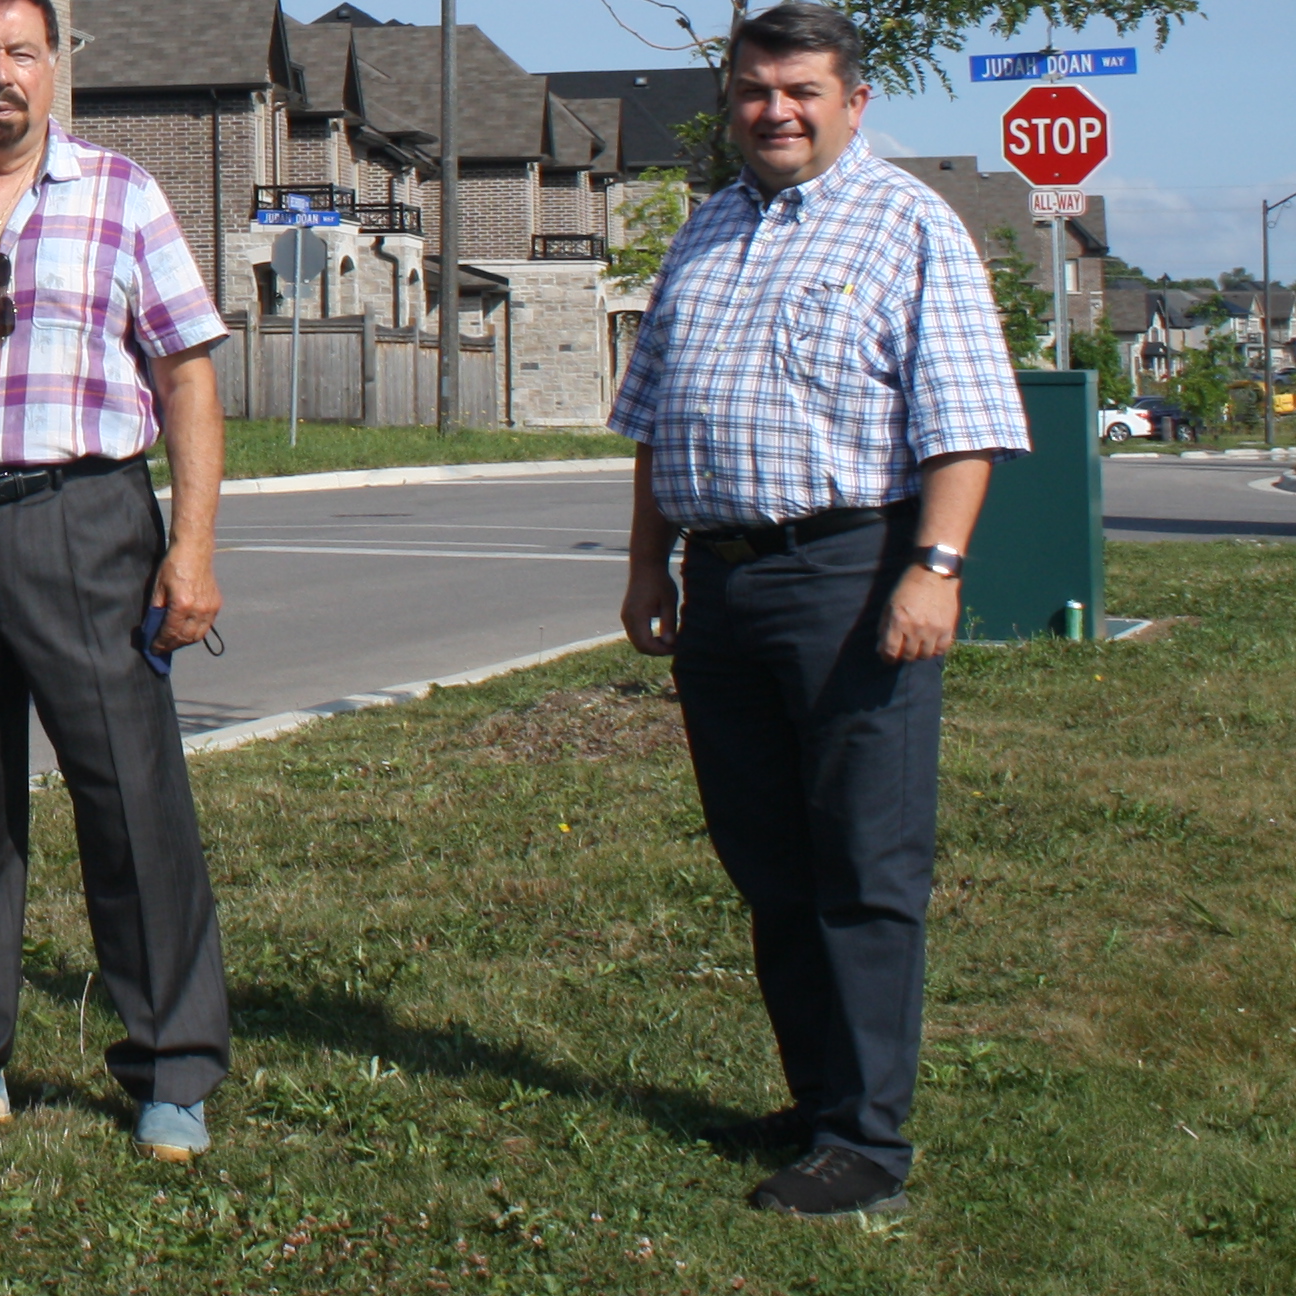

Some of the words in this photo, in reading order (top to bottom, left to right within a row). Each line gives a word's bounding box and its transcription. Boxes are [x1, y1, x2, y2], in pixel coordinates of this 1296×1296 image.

[982, 57, 1037, 79] JUDAH
[1047, 54, 1093, 75] DOAN
[1102, 56, 1125, 68] WAY
[1009, 117, 1102, 155] STOP
[1034, 194, 1081, 210] ALL-WAY
